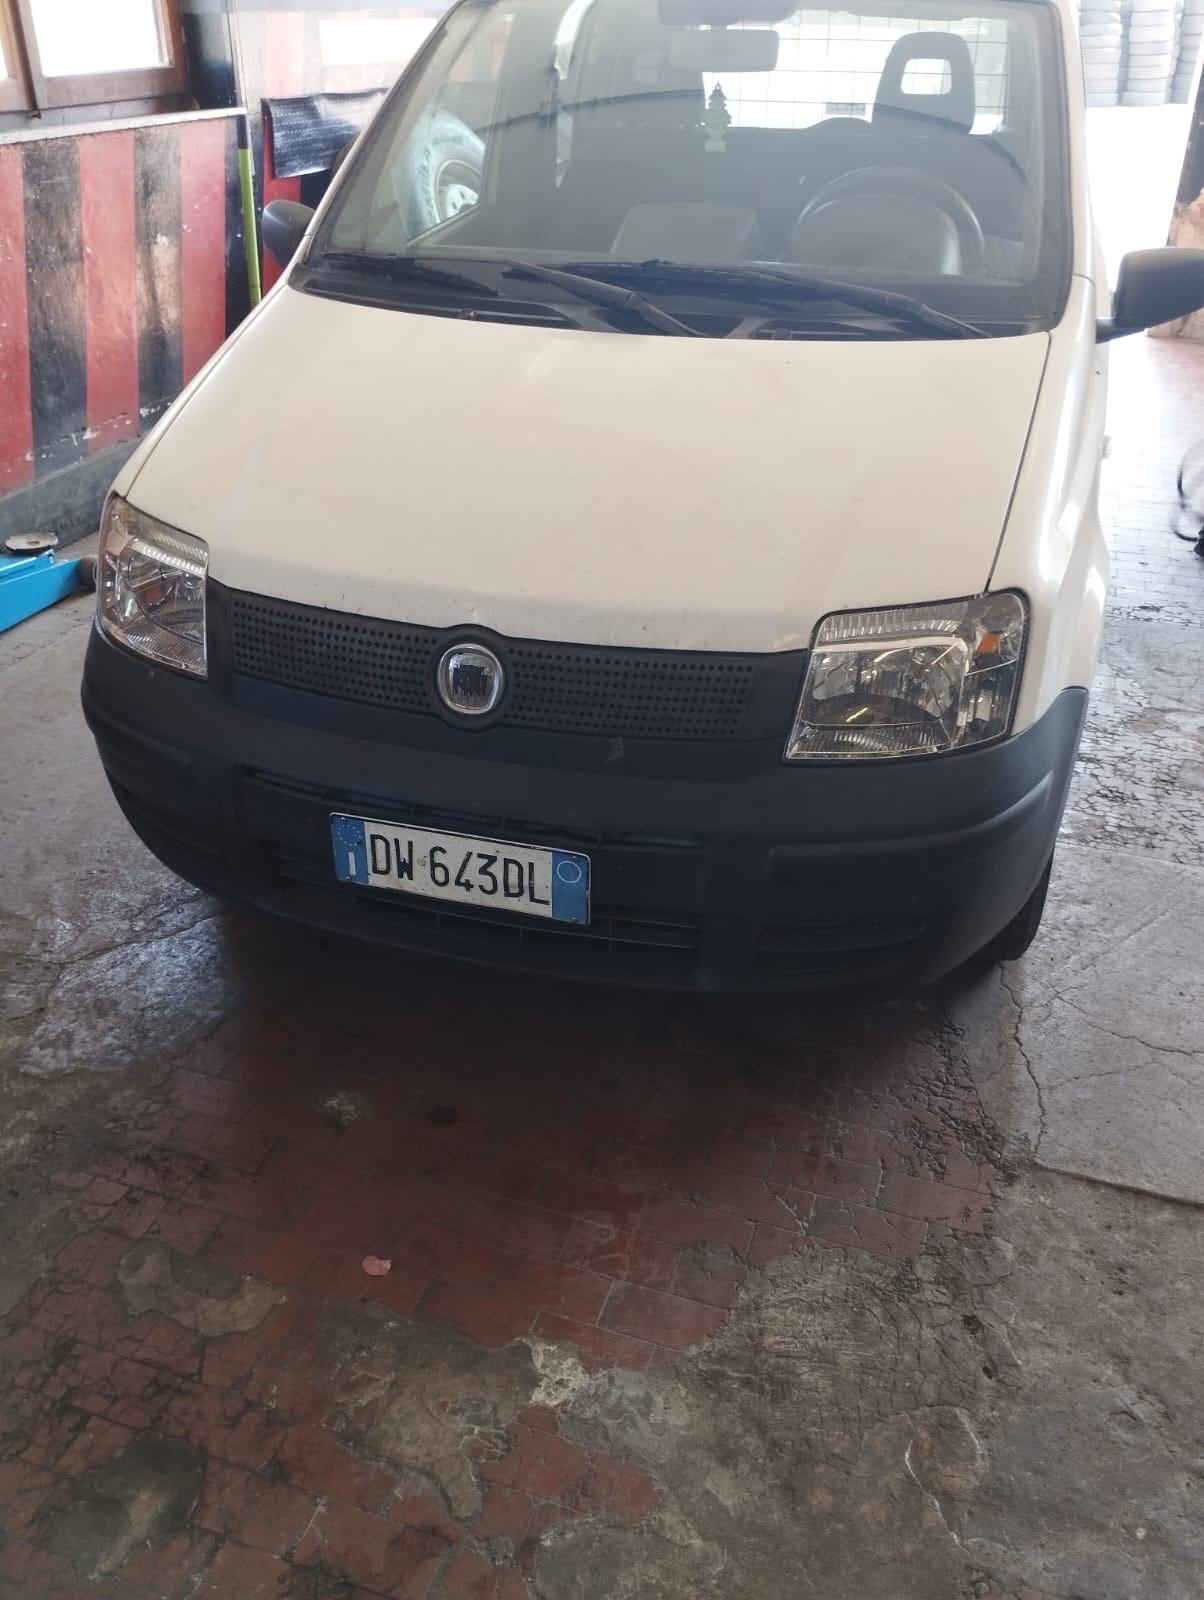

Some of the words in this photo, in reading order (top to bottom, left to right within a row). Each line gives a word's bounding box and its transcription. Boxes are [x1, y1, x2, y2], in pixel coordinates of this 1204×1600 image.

[348, 851, 356, 876] I
[369, 834, 414, 881] DW
[429, 846, 550, 906] 643DL
